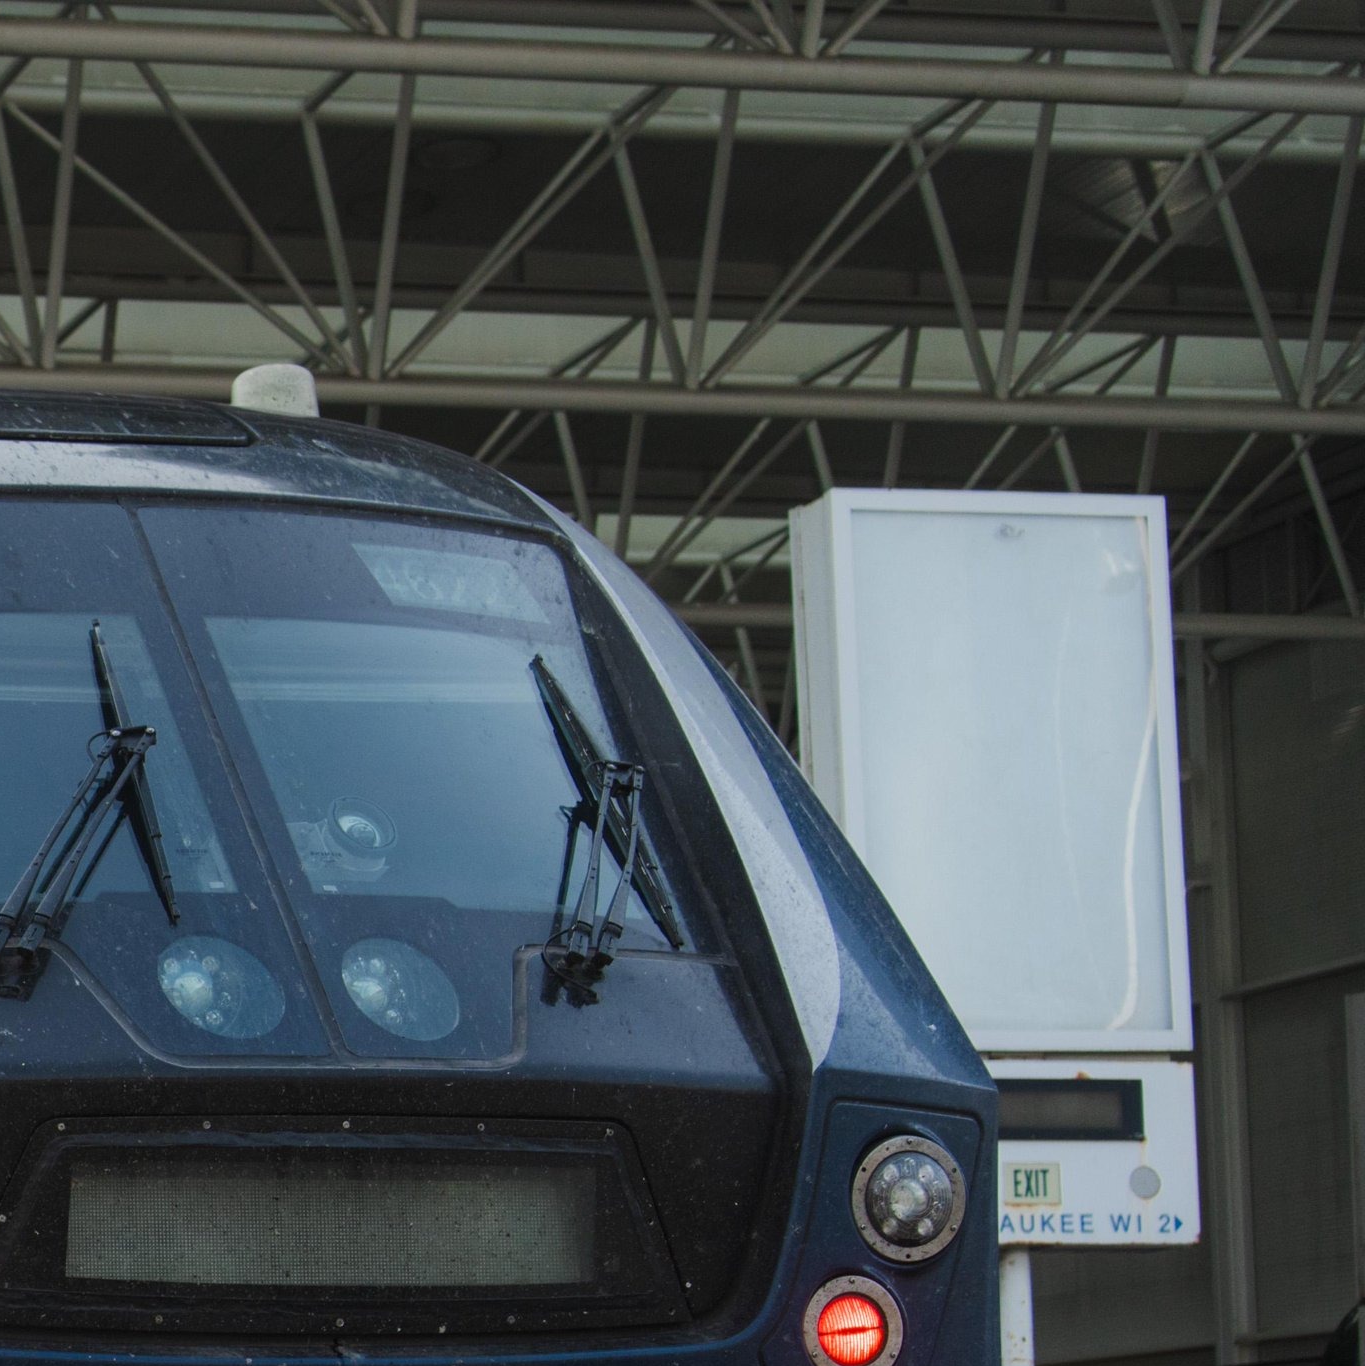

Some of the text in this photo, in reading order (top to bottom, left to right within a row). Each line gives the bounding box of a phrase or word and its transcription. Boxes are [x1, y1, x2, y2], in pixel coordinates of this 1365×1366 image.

[1013, 1168, 1049, 1198] EXIT
[1000, 1213, 1171, 1234] AUKEE WI 2
